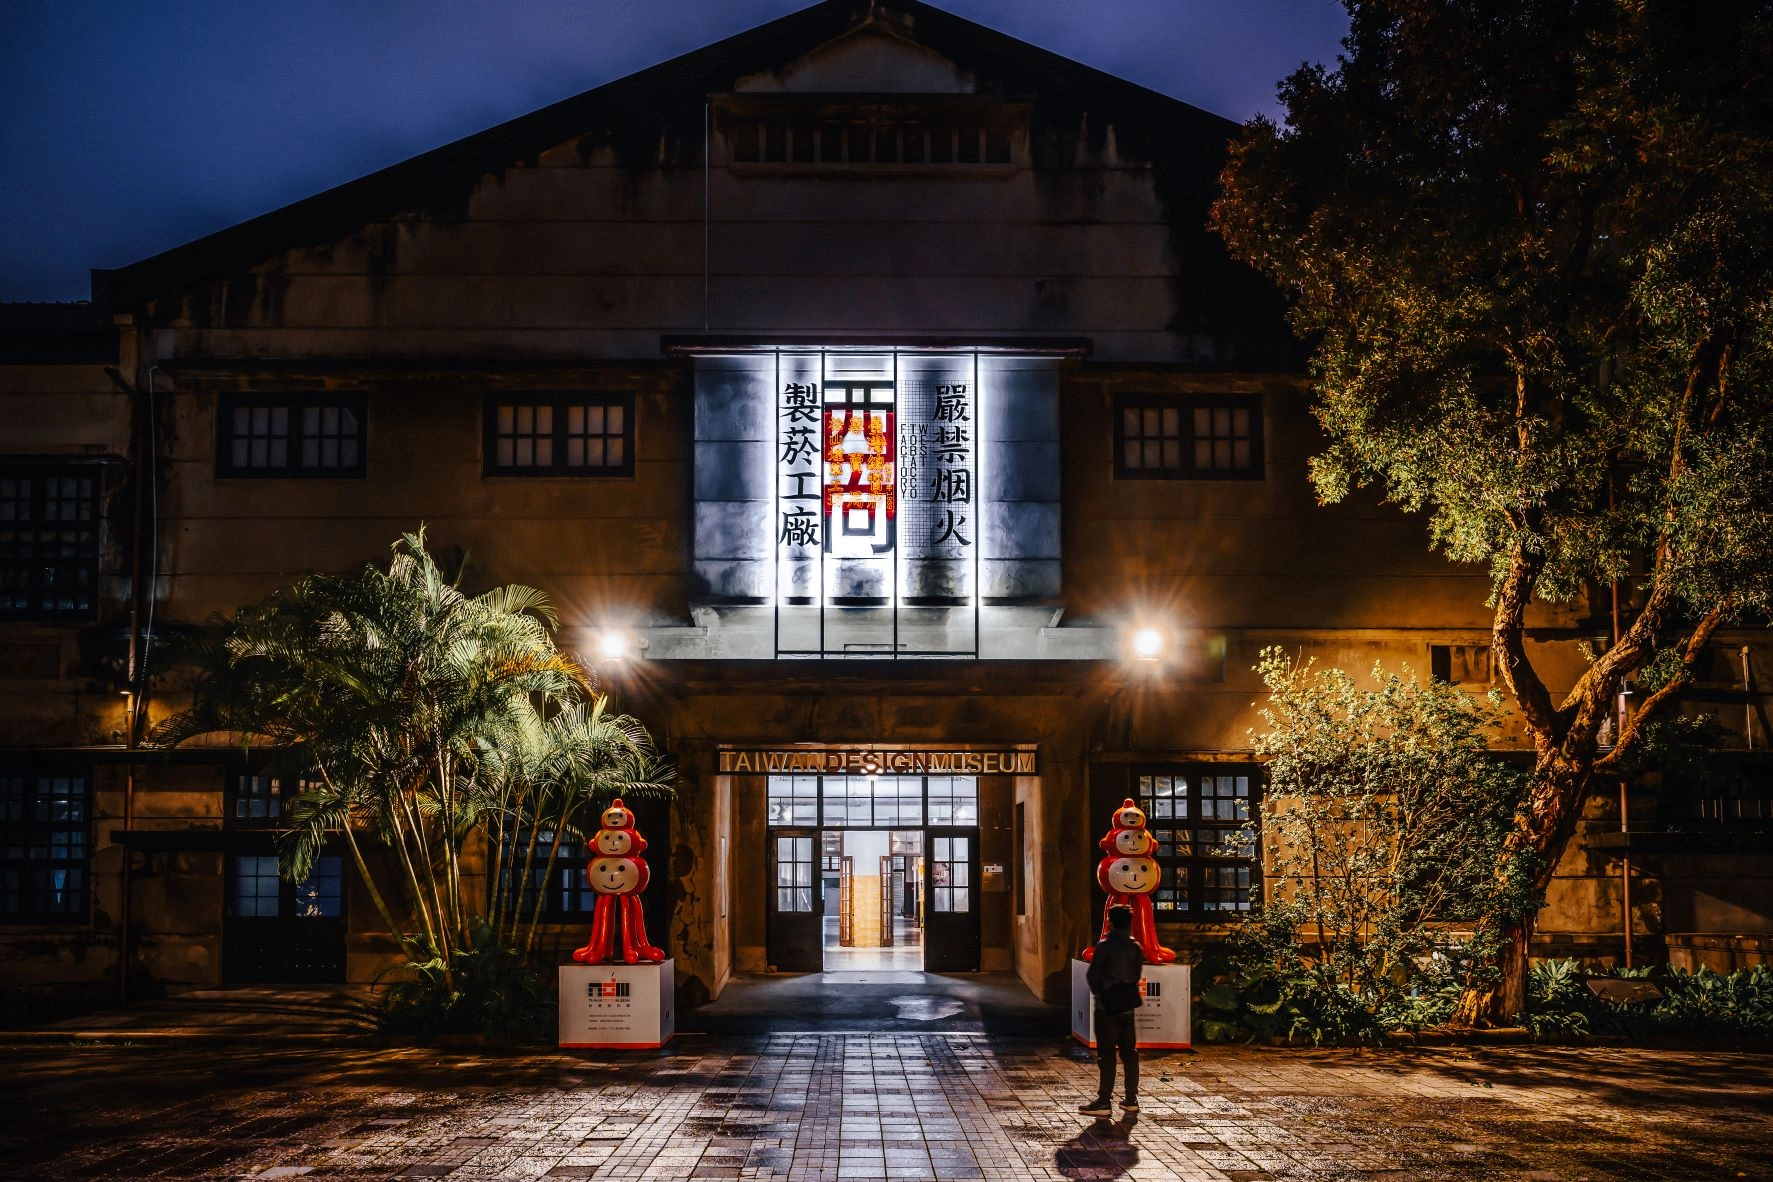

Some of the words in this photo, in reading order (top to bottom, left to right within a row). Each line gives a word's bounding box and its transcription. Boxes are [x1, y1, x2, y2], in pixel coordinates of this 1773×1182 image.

[779, 382, 821, 547] 製菸工廠
[900, 423, 908, 500] FACTORY
[909, 423, 918, 500] TOBACCO
[918, 423, 929, 467] WEST
[930, 384, 972, 546] 嚴禁烟火
